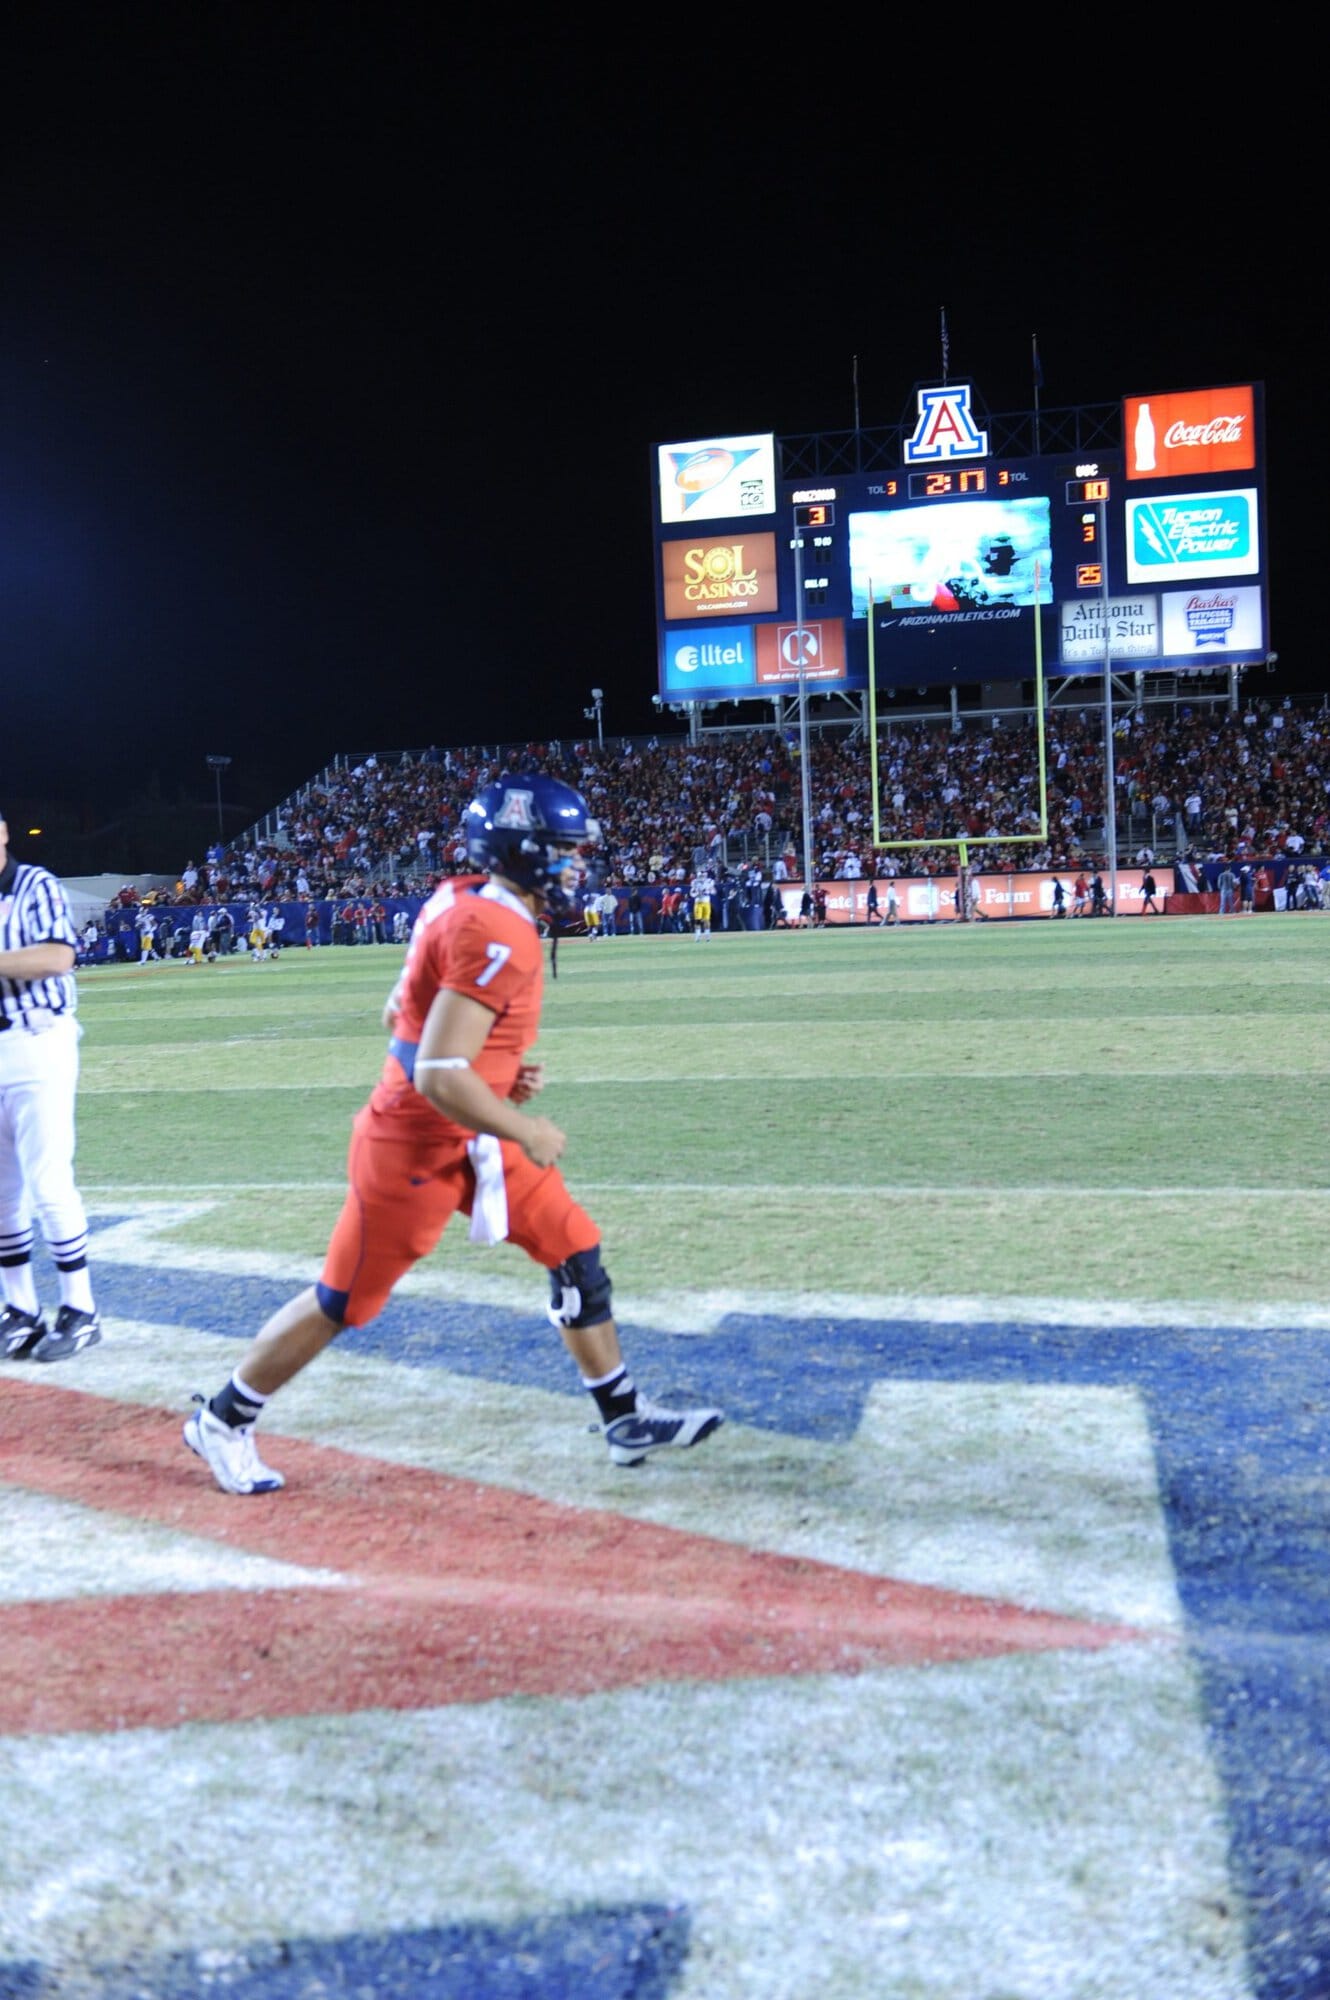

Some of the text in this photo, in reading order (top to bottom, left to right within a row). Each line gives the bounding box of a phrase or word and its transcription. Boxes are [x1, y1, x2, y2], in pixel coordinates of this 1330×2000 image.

[904, 385, 988, 464] A
[1164, 415, 1246, 448] Coca-Cola
[926, 470, 985, 495] 2:17
[998, 471, 1029, 485] 3 TOL
[868, 481, 897, 495] TOL 3
[1085, 481, 1108, 500] 10
[808, 506, 826, 526] 3
[1162, 507, 1223, 525] Tucson
[1083, 526, 1095, 542] 3
[1168, 520, 1240, 539] Electric
[1176, 537, 1239, 554] Power
[684, 545, 758, 585] SOL
[1078, 565, 1101, 585] 25
[684, 579, 759, 600] CASINOS
[899, 608, 1021, 627] ARIZONAATHLETICS.COM
[1073, 602, 1144, 621] Arizona
[1062, 620, 1156, 643] Daily Star
[494, 788, 535, 831] A
[984, 887, 1033, 905] Farm
[475, 942, 512, 987] 7
